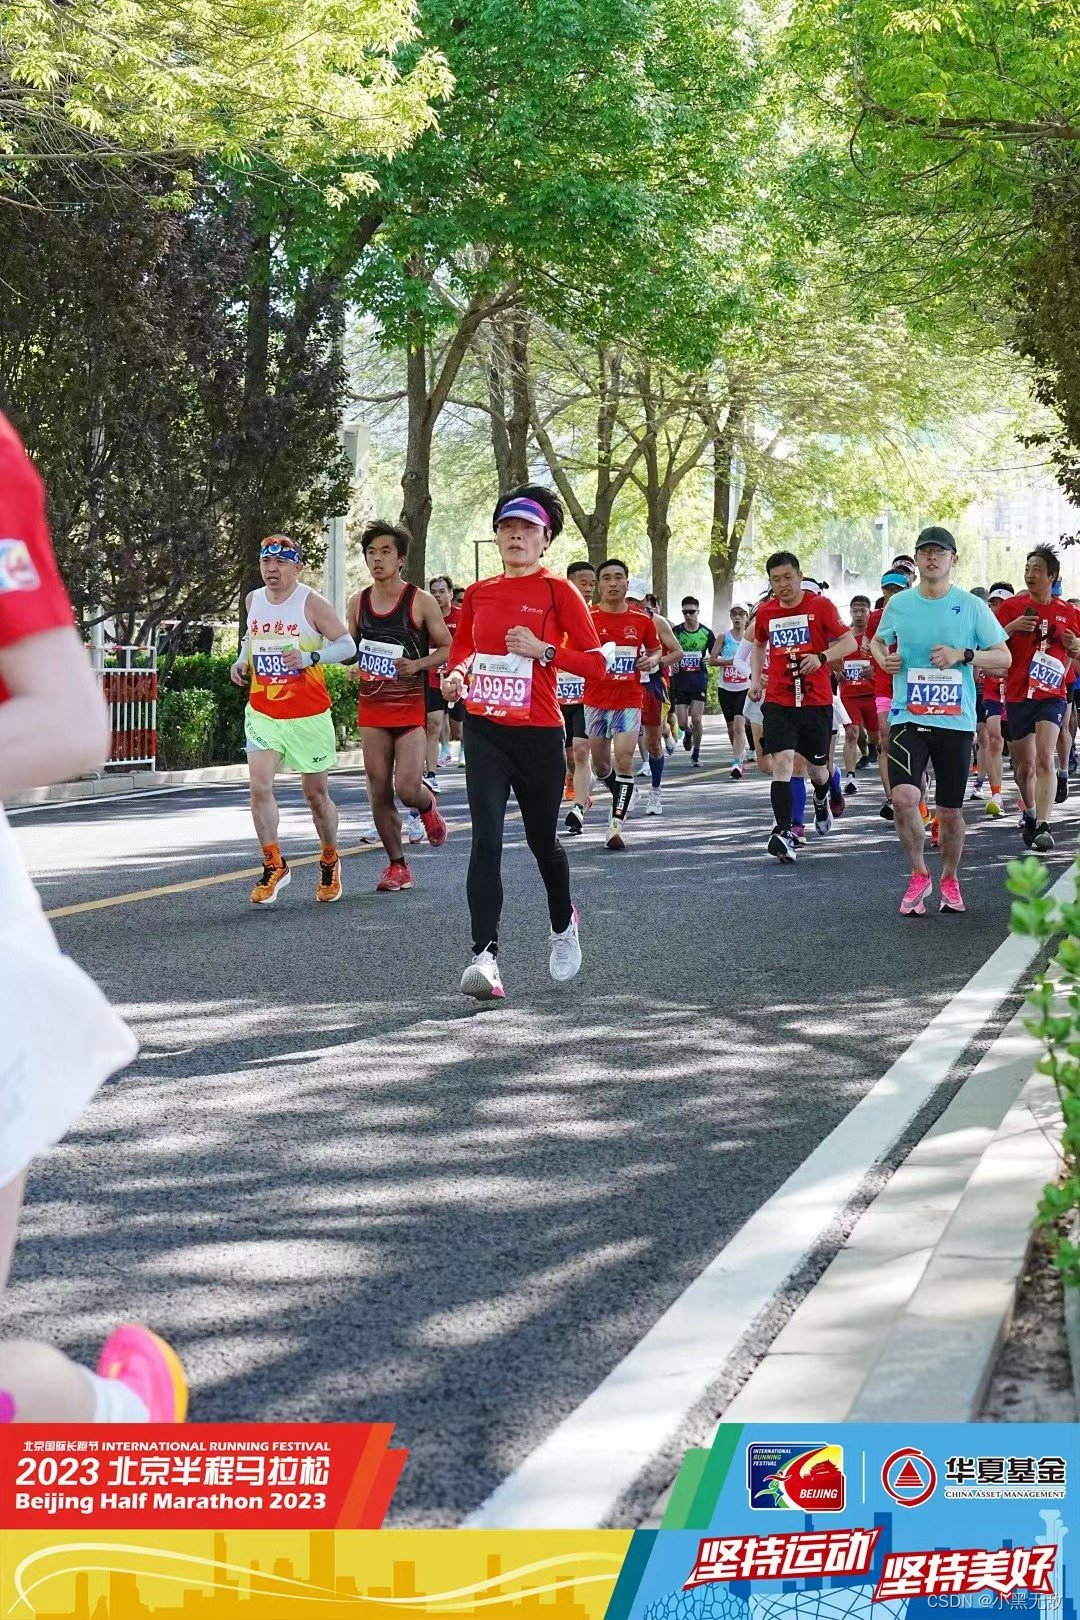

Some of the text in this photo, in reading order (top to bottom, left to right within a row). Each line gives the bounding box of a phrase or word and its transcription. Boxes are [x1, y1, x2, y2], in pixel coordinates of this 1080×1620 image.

[772, 627, 807, 646] A3217
[256, 655, 289, 673] A389
[360, 653, 396, 675] A0885
[609, 658, 635, 671] 0477
[680, 658, 700, 668] A0517
[1029, 663, 1063, 686] A3777
[473, 675, 526, 702] A9959
[910, 684, 959, 703] A1284
